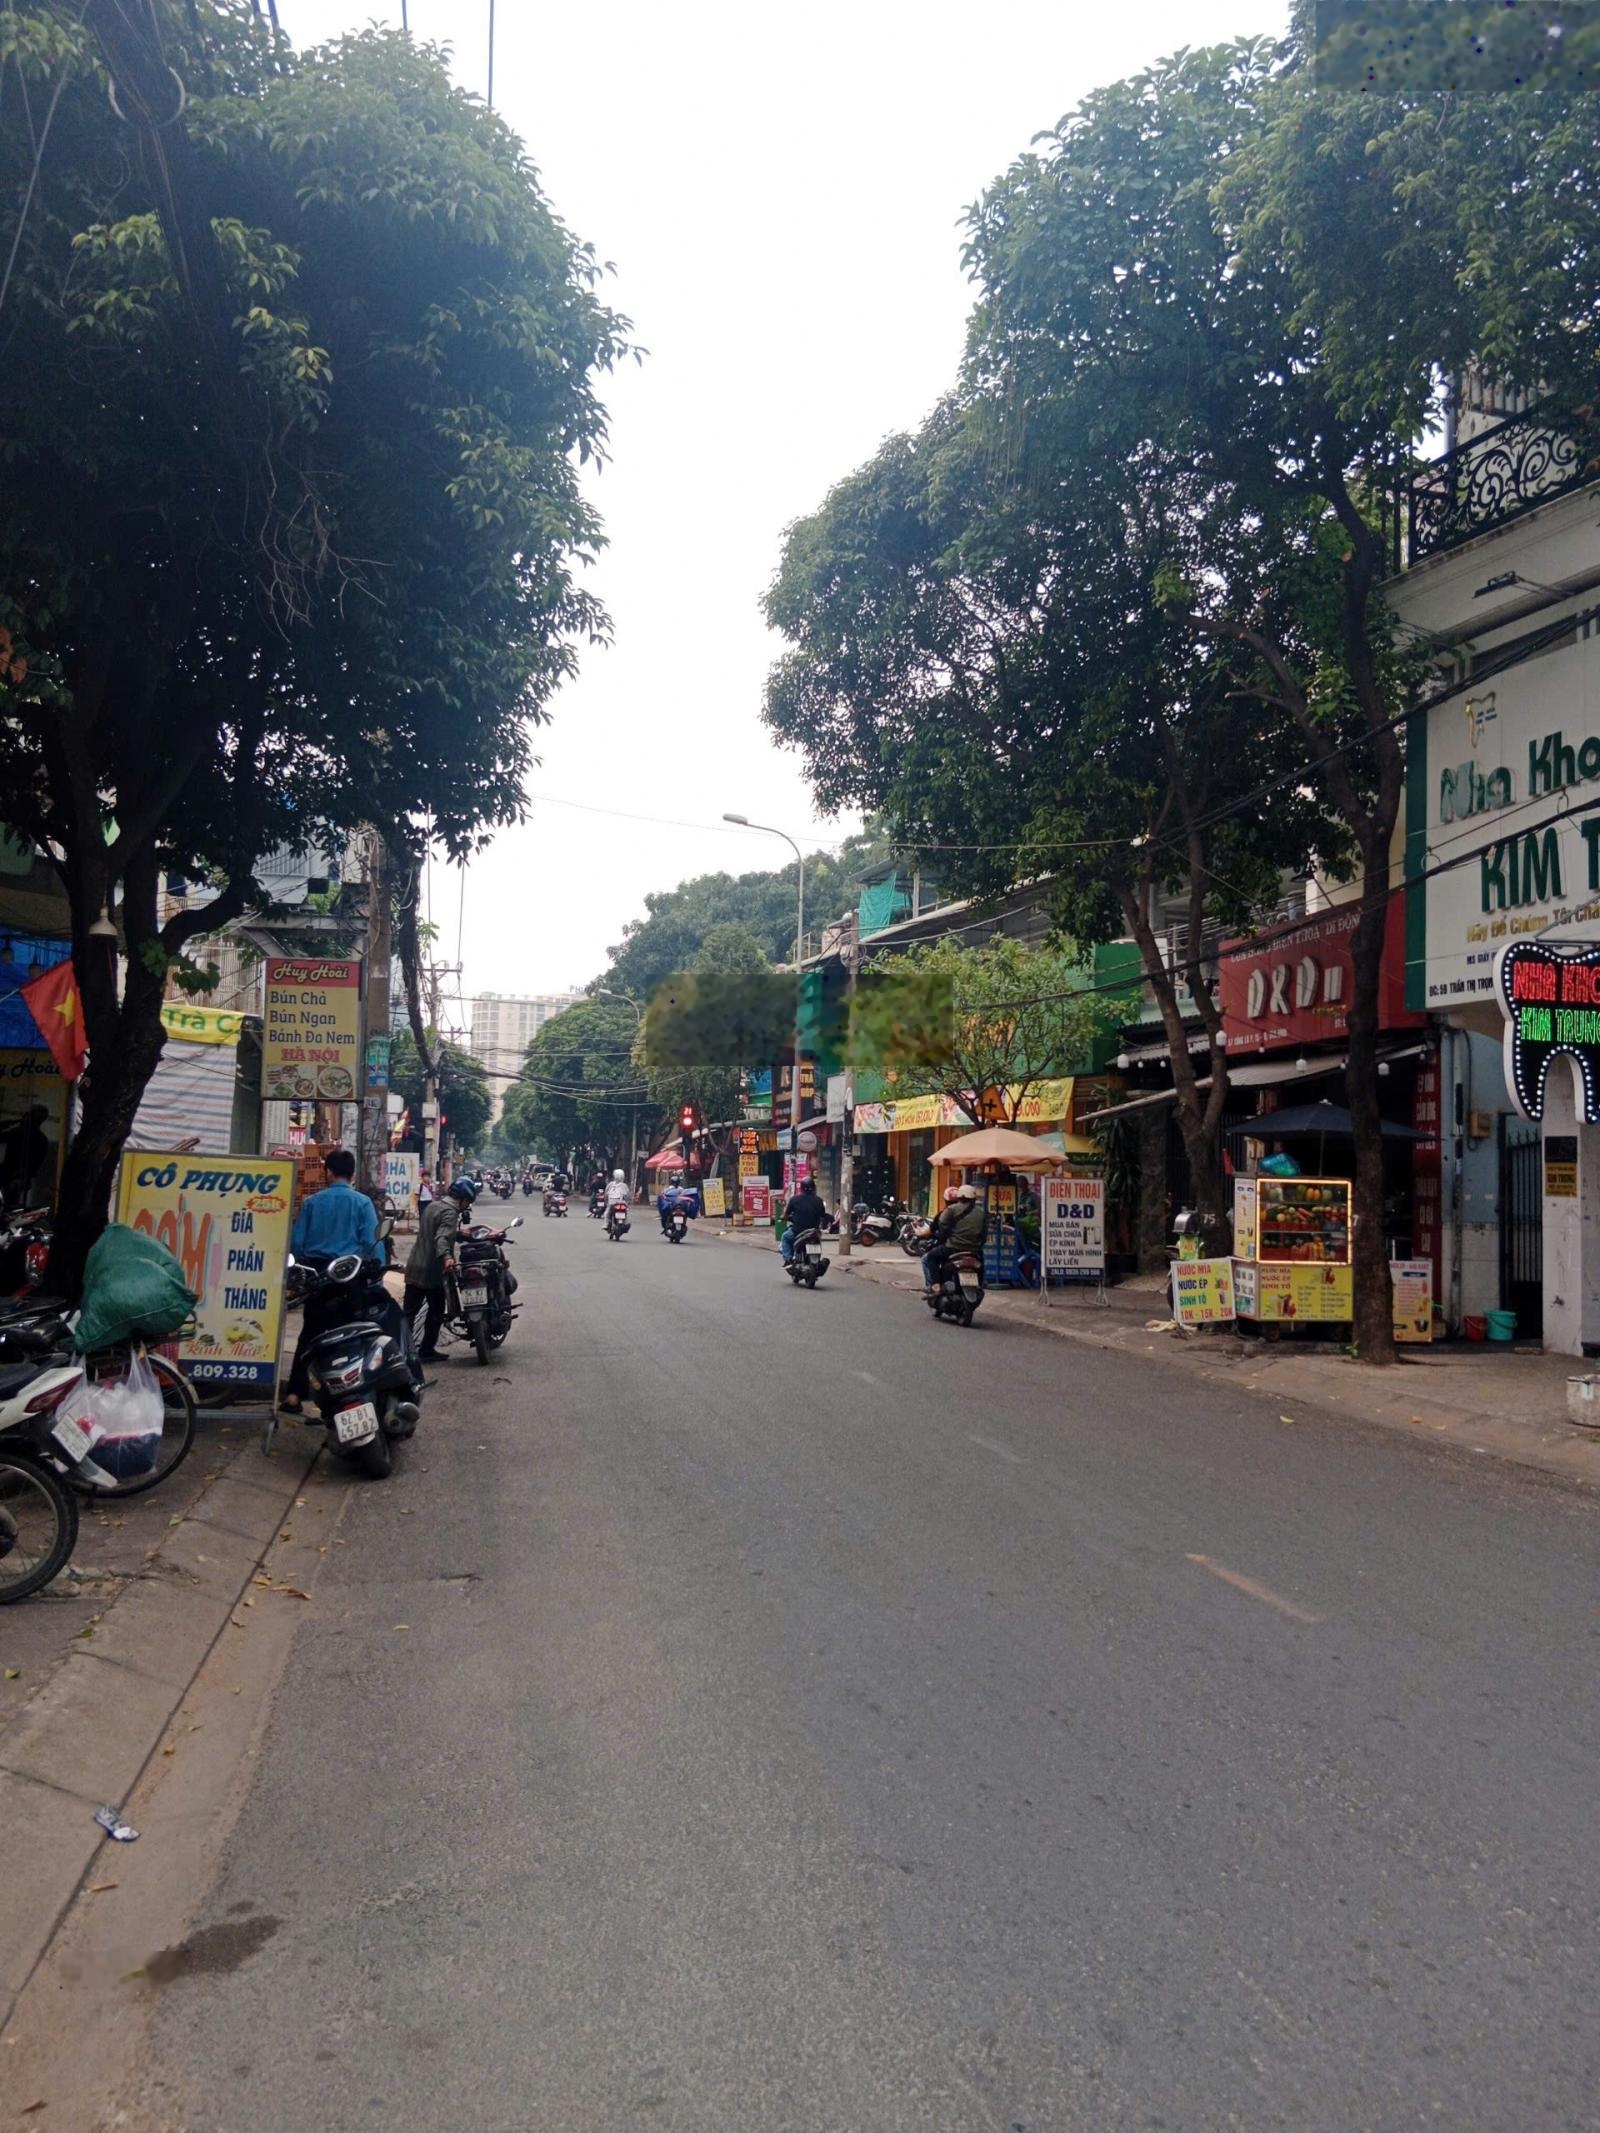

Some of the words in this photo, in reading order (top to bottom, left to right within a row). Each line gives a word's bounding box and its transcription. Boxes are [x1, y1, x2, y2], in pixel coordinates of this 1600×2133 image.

[1440, 760, 1512, 822] Nha
[1481, 827, 1562, 912] KIM
[273, 963, 308, 982] Huy
[310, 963, 348, 980] Hoài
[1513, 961, 1556, 1000] NHA
[1478, 976, 1494, 991] TRỌN
[270, 990, 297, 1004] Bún
[163, 1007, 205, 1031] Trà
[269, 1009, 296, 1023] Bún
[300, 1011, 336, 1027] Ngan
[1520, 1007, 1551, 1042] KIM
[269, 1028, 302, 1042] Bánh
[305, 1031, 322, 1043] Đa
[326, 1032, 355, 1044] Nem
[281, 1046, 306, 1061] HÀ
[308, 1047, 340, 1064] NỘI
[137, 1162, 178, 1188] CÔ
[180, 1170, 281, 1198] PHỤNG
[386, 1176, 410, 1195] ÁCH
[1049, 1182, 1071, 1202] ĐIỆN
[1074, 1182, 1101, 1203] THOẠI
[1057, 1203, 1095, 1219] D&D
[1202, 1213, 1216, 1225] 75
[1199, 1276, 1208, 1289] ÉP
[224, 1284, 267, 1310] THÁNG
[1179, 1295, 1196, 1306] SINH
[1198, 1292, 1207, 1305] TỐ
